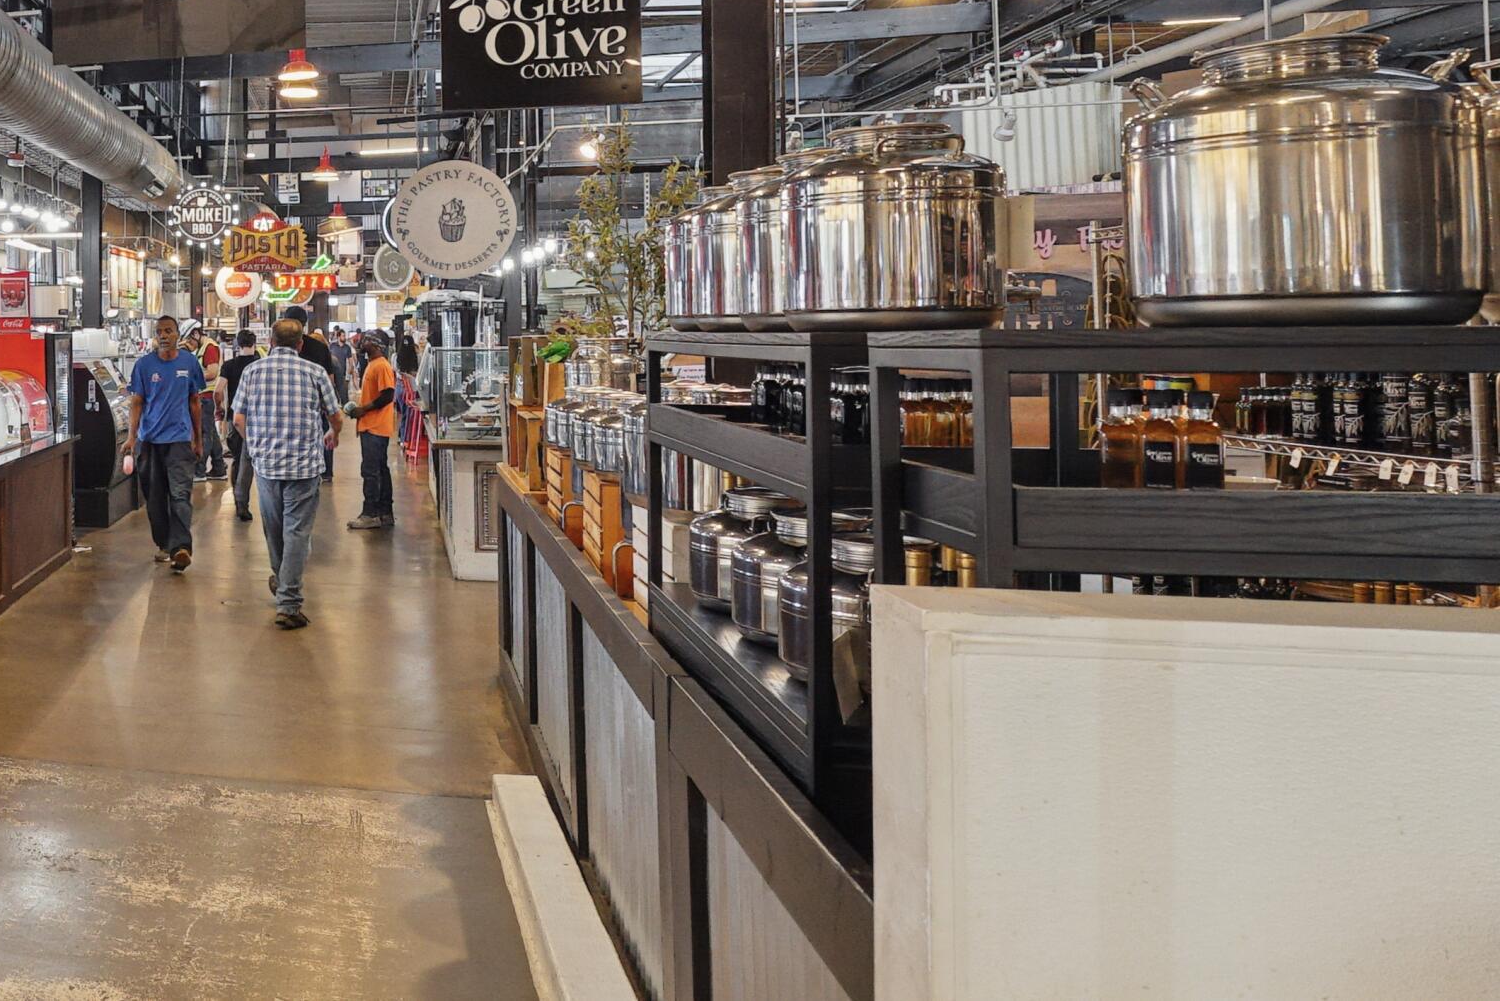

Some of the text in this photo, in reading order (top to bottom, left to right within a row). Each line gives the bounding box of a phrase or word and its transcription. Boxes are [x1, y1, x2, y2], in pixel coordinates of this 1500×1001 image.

[484, 17, 628, 66] Olive
[520, 59, 626, 80] COMPANY
[396, 169, 511, 228] THE PASTRY FACTORY
[172, 205, 232, 225] SMOKED
[253, 217, 276, 232] EAT
[192, 223, 213, 235] BBQ
[231, 228, 299, 262] PASTA
[407, 241, 498, 271] GOURMET DESSERTS
[241, 263, 287, 271] PASTARIA
[277, 275, 332, 289] PIZZA
